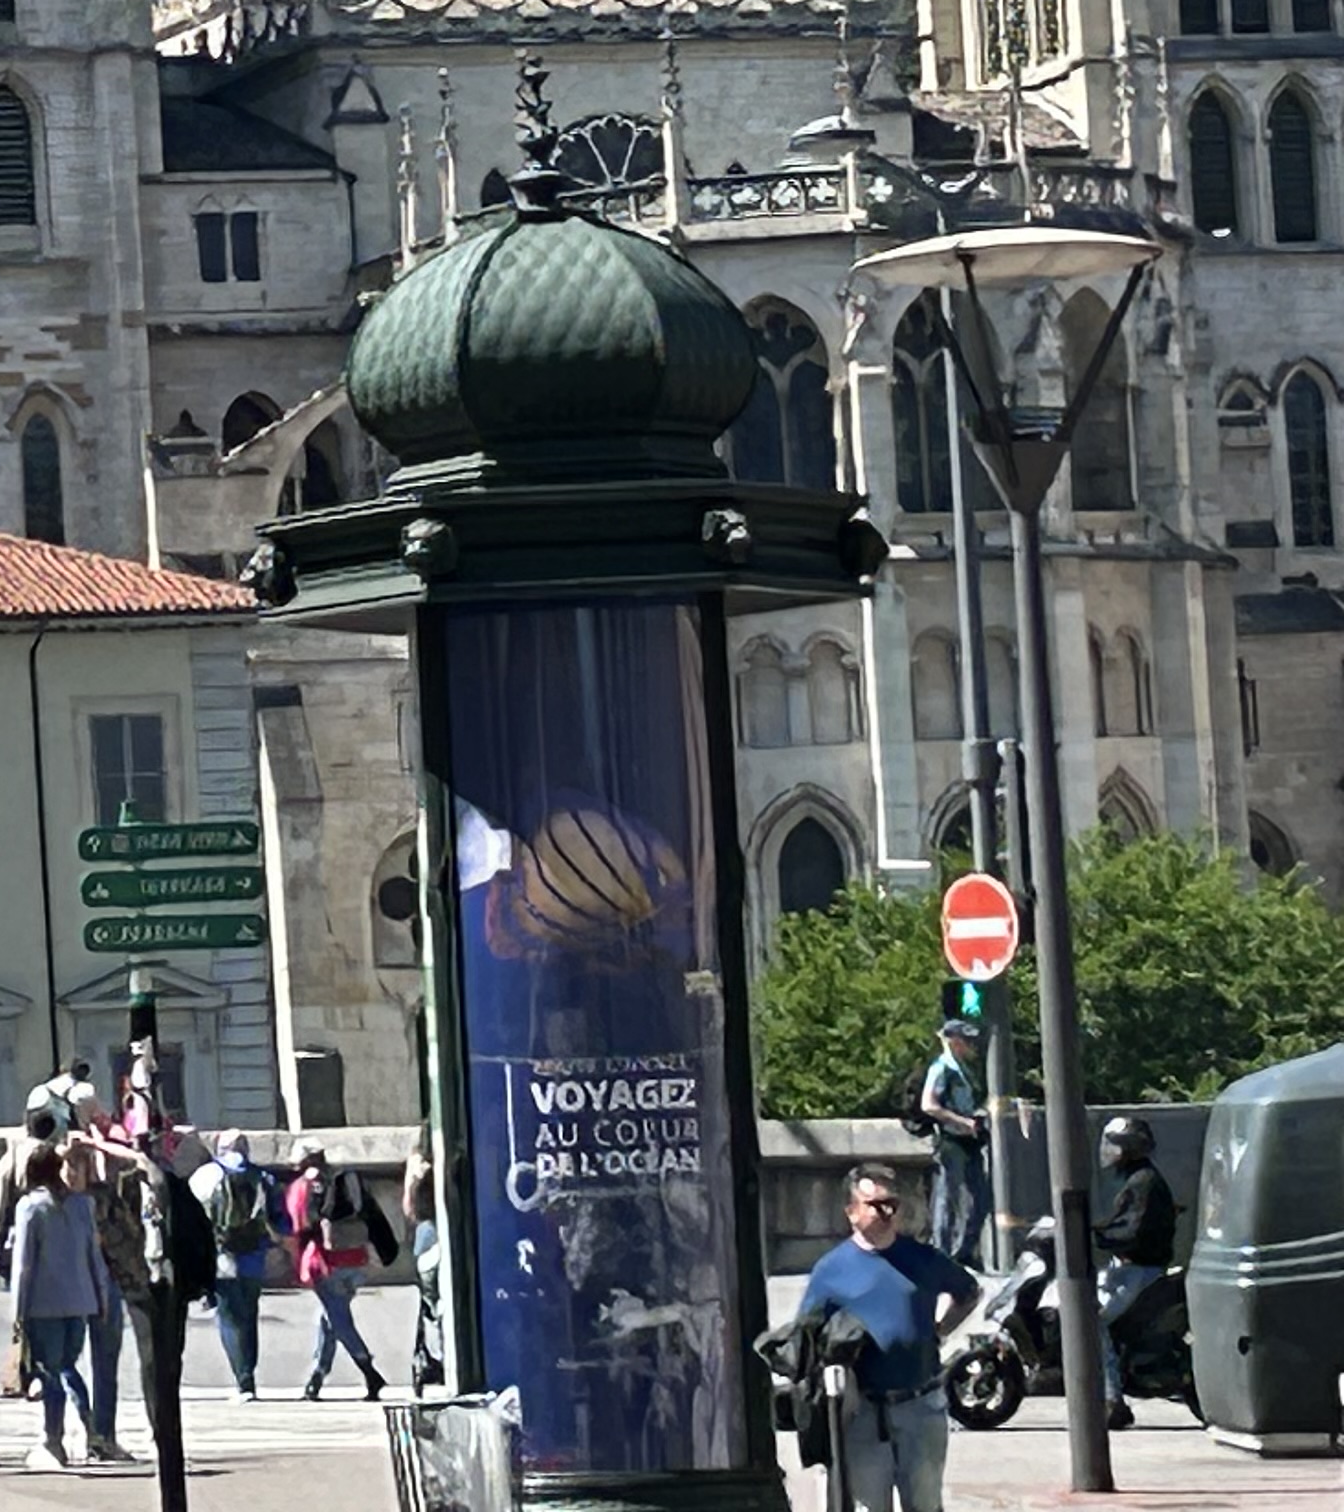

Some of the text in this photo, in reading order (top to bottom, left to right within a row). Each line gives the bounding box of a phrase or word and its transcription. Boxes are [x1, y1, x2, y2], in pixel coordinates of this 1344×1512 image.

[530, 1079, 696, 1114] VOYAGEZ
[535, 1122, 578, 1148] AU
[536, 1151, 574, 1179] DE
